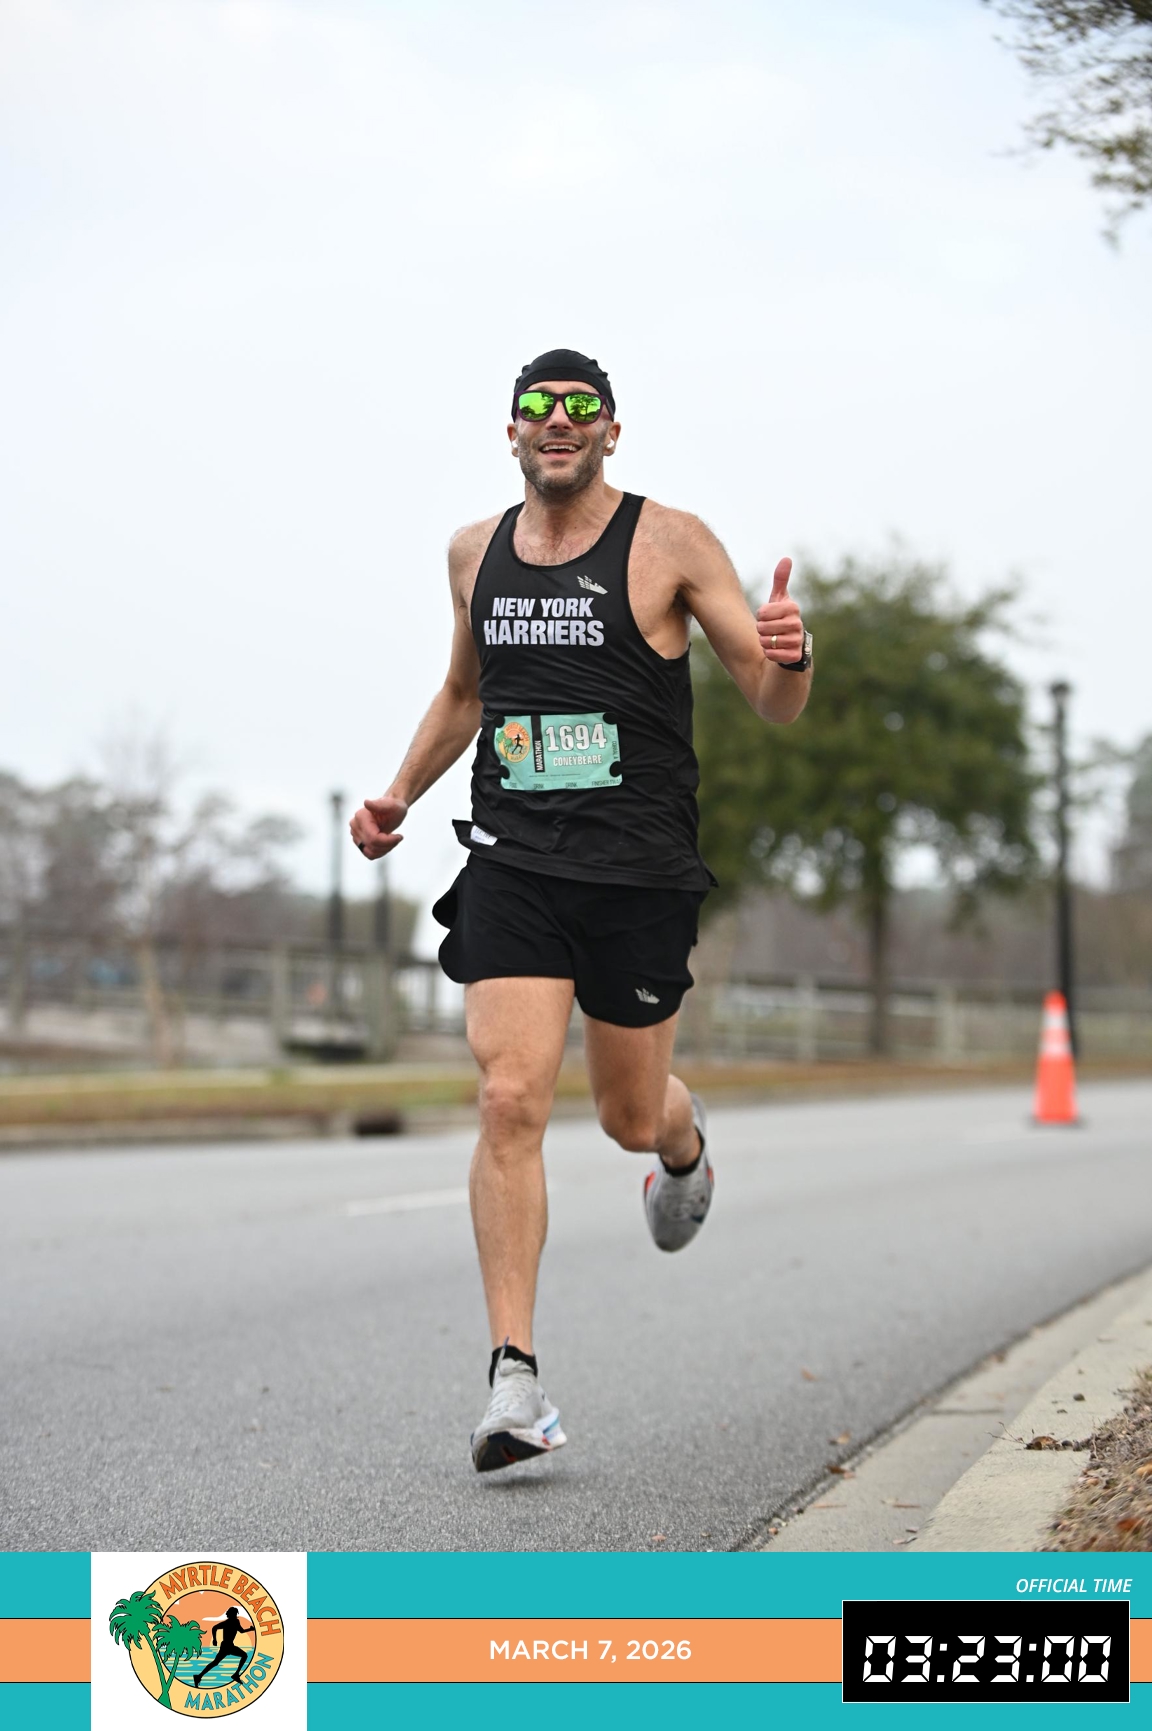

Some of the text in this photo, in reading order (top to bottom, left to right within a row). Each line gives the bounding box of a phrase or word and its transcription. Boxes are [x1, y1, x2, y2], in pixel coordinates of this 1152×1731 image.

[492, 597, 594, 617] NEW YORK
[483, 619, 605, 646] HARRIERS
[545, 723, 607, 752] 1694
[534, 740, 544, 771] MARATHON
[553, 754, 602, 767] CONEYBEARE
